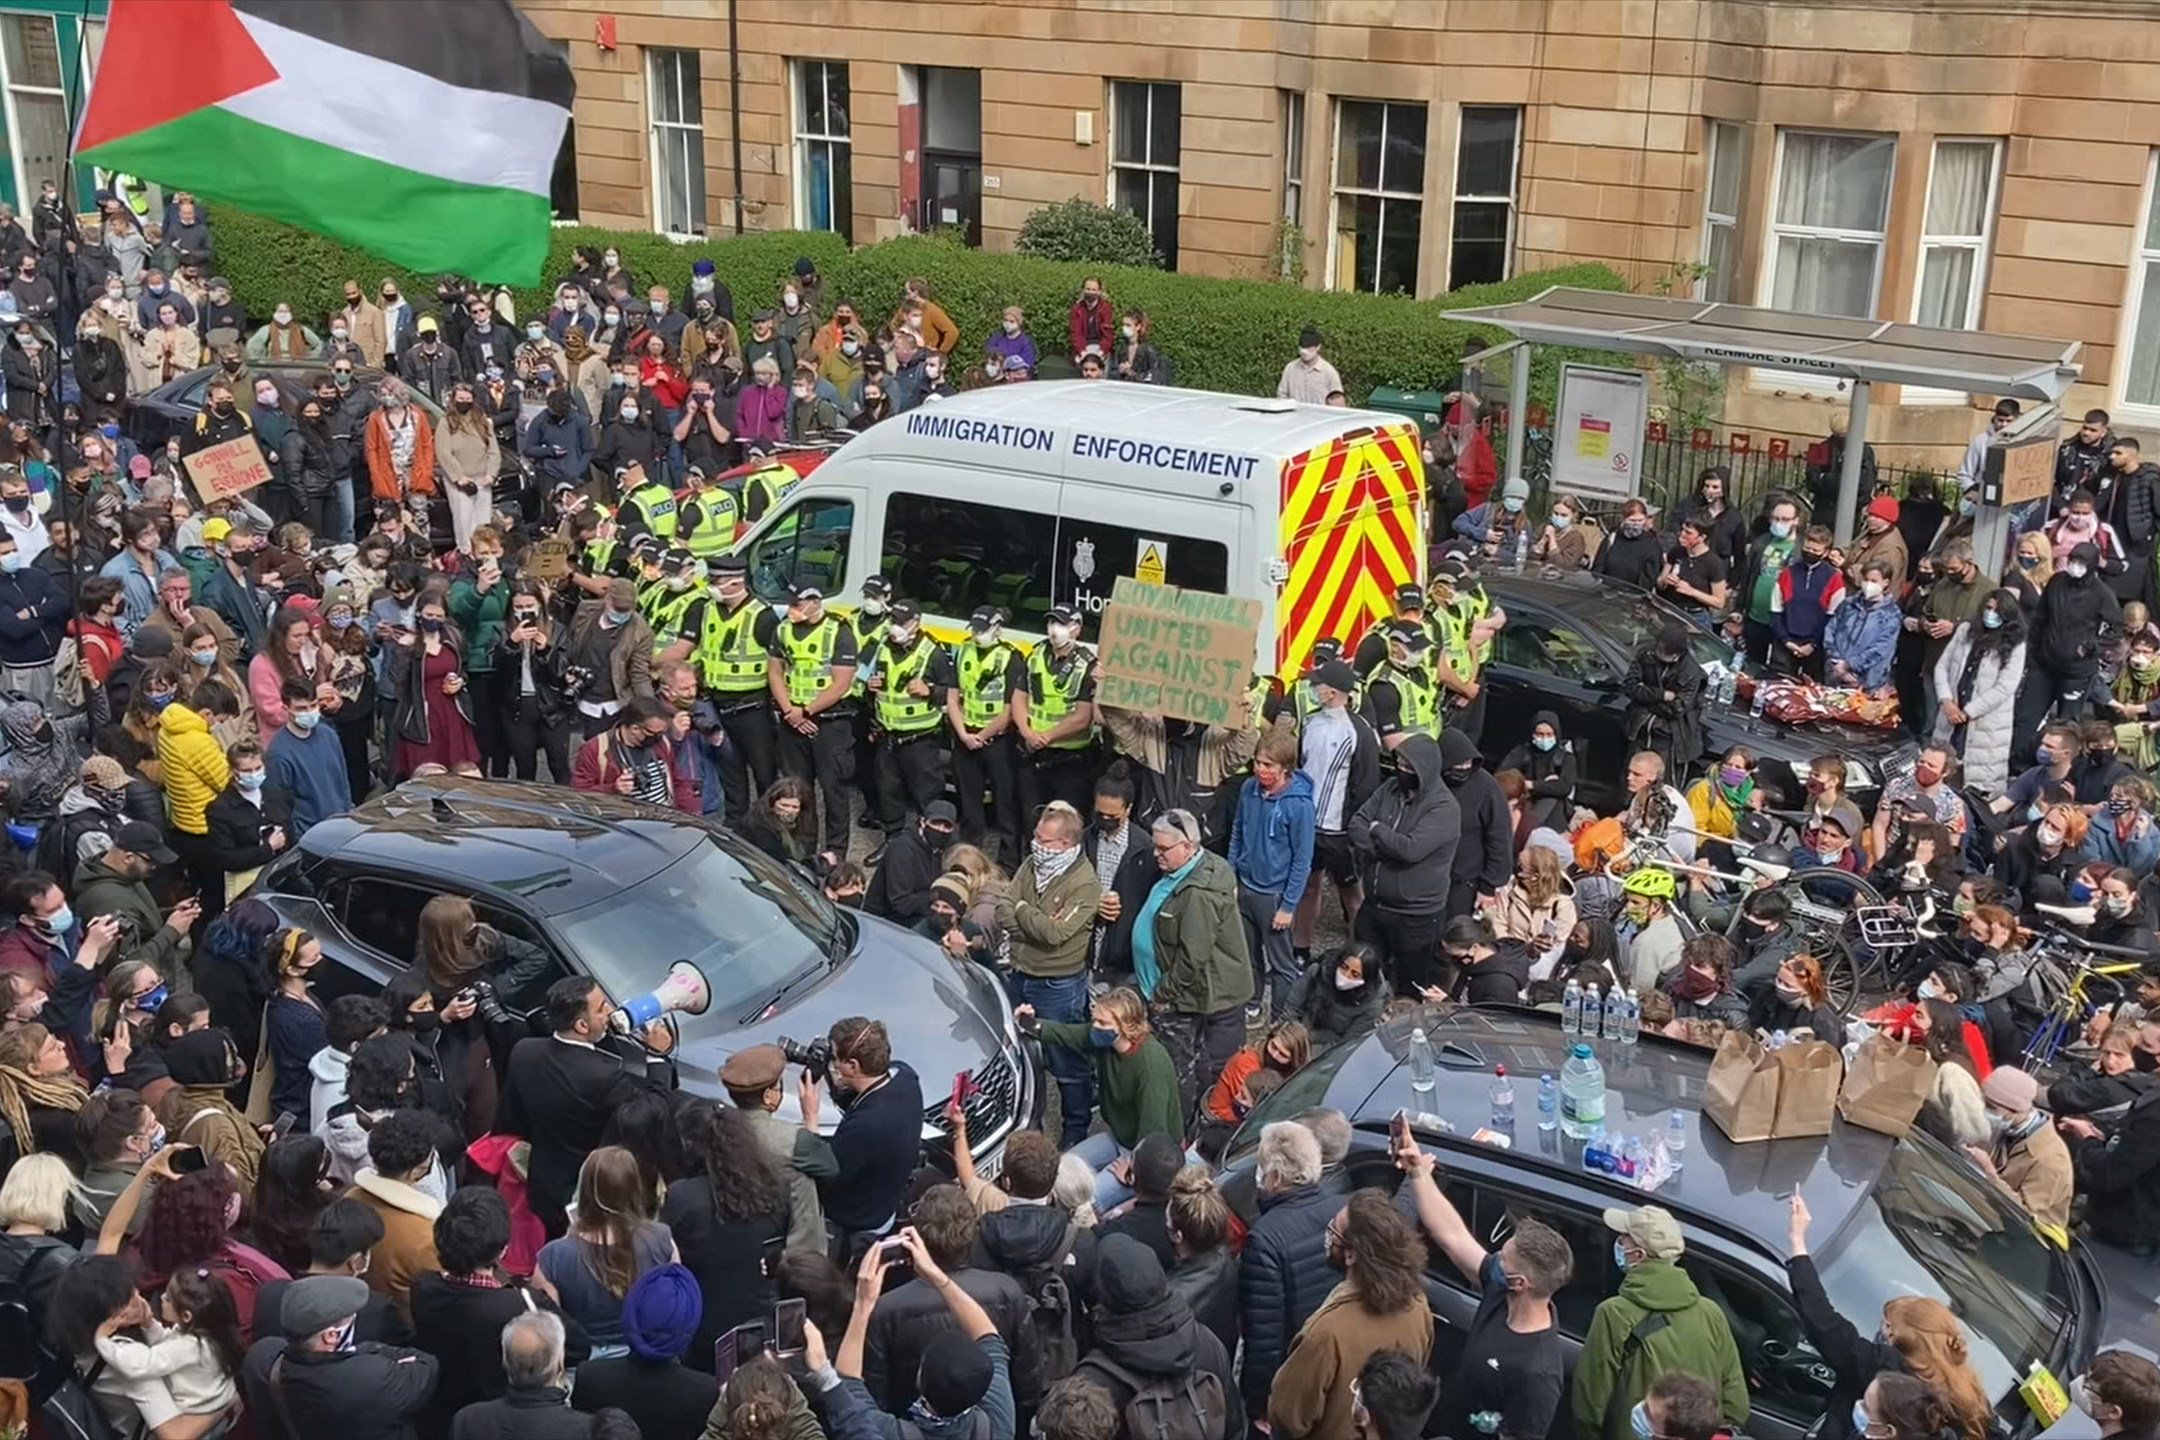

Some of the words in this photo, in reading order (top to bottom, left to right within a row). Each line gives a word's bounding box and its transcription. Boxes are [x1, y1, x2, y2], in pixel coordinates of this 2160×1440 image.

[1780, 356, 1836, 369] STREET
[907, 414, 1054, 451] IMMIGRATION
[1073, 434, 1260, 480] ENFORCEMENT
[1115, 611, 1211, 650] UNITED
[1106, 642, 1242, 694] AGAINST
[1102, 674, 1230, 724] EVICTION
